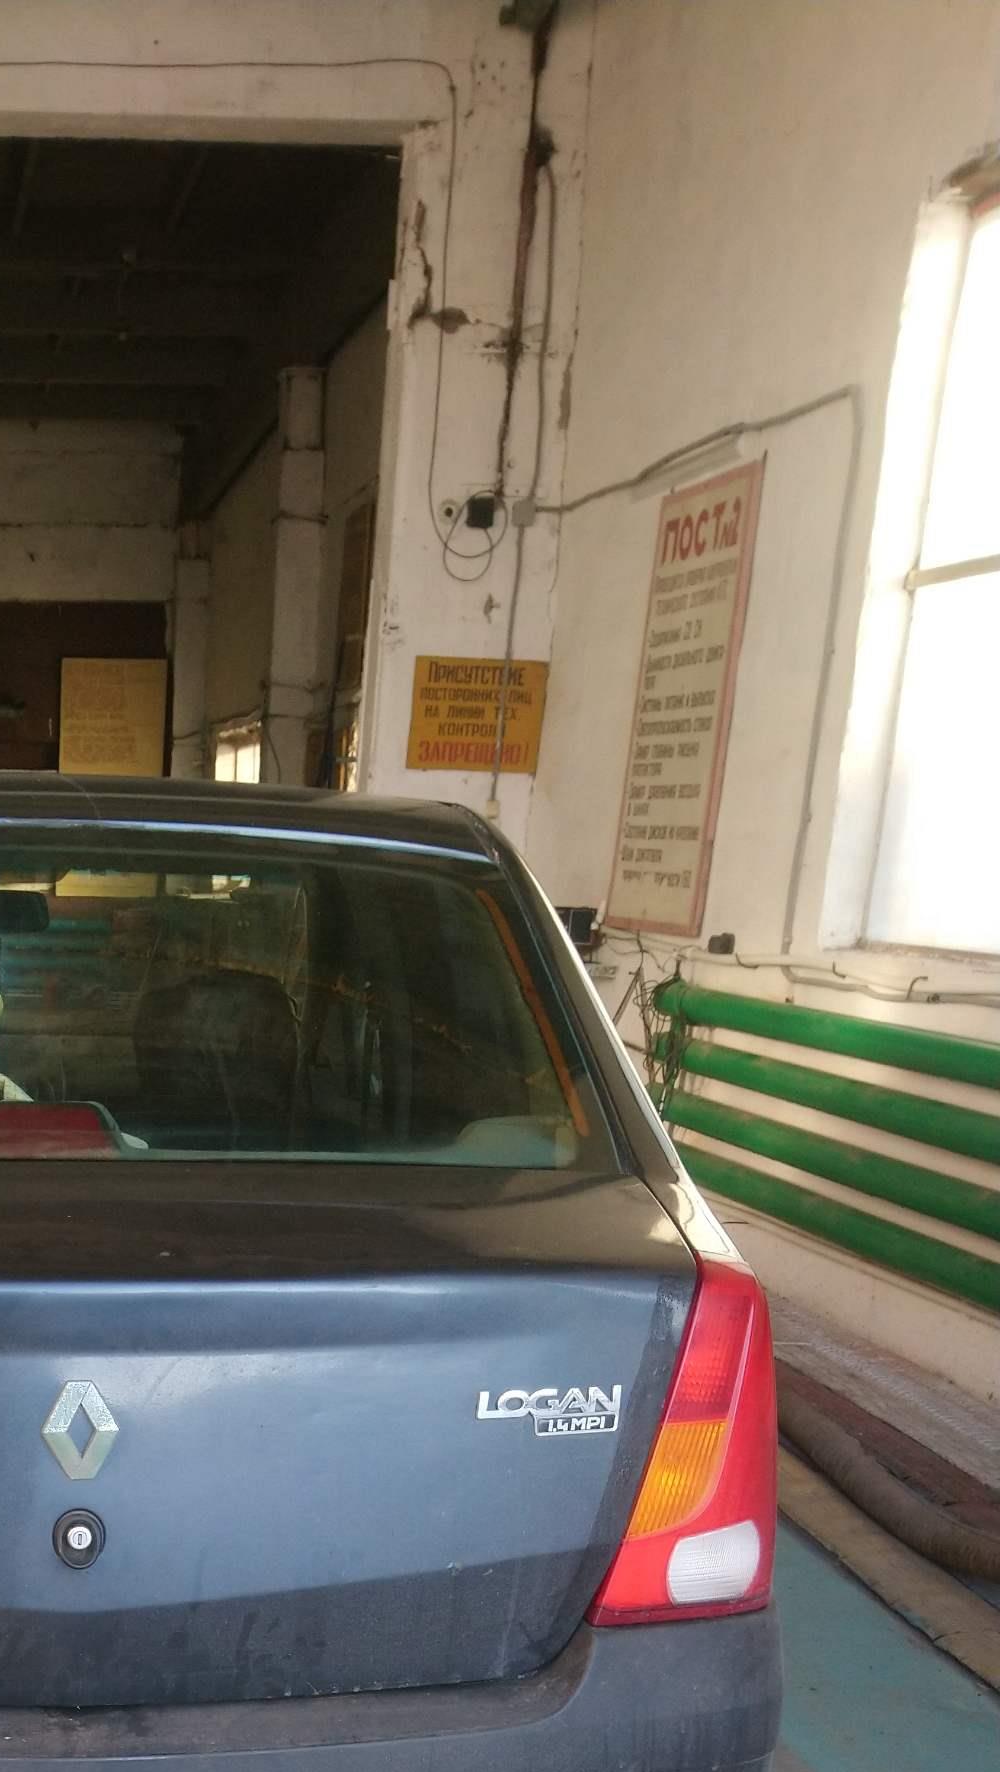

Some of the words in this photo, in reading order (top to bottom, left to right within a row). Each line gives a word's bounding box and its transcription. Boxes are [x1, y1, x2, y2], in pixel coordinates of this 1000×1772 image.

[661, 501, 727, 566] ПОСТ
[424, 705, 439, 718] НА
[477, 1384, 622, 1420] LOGAN
